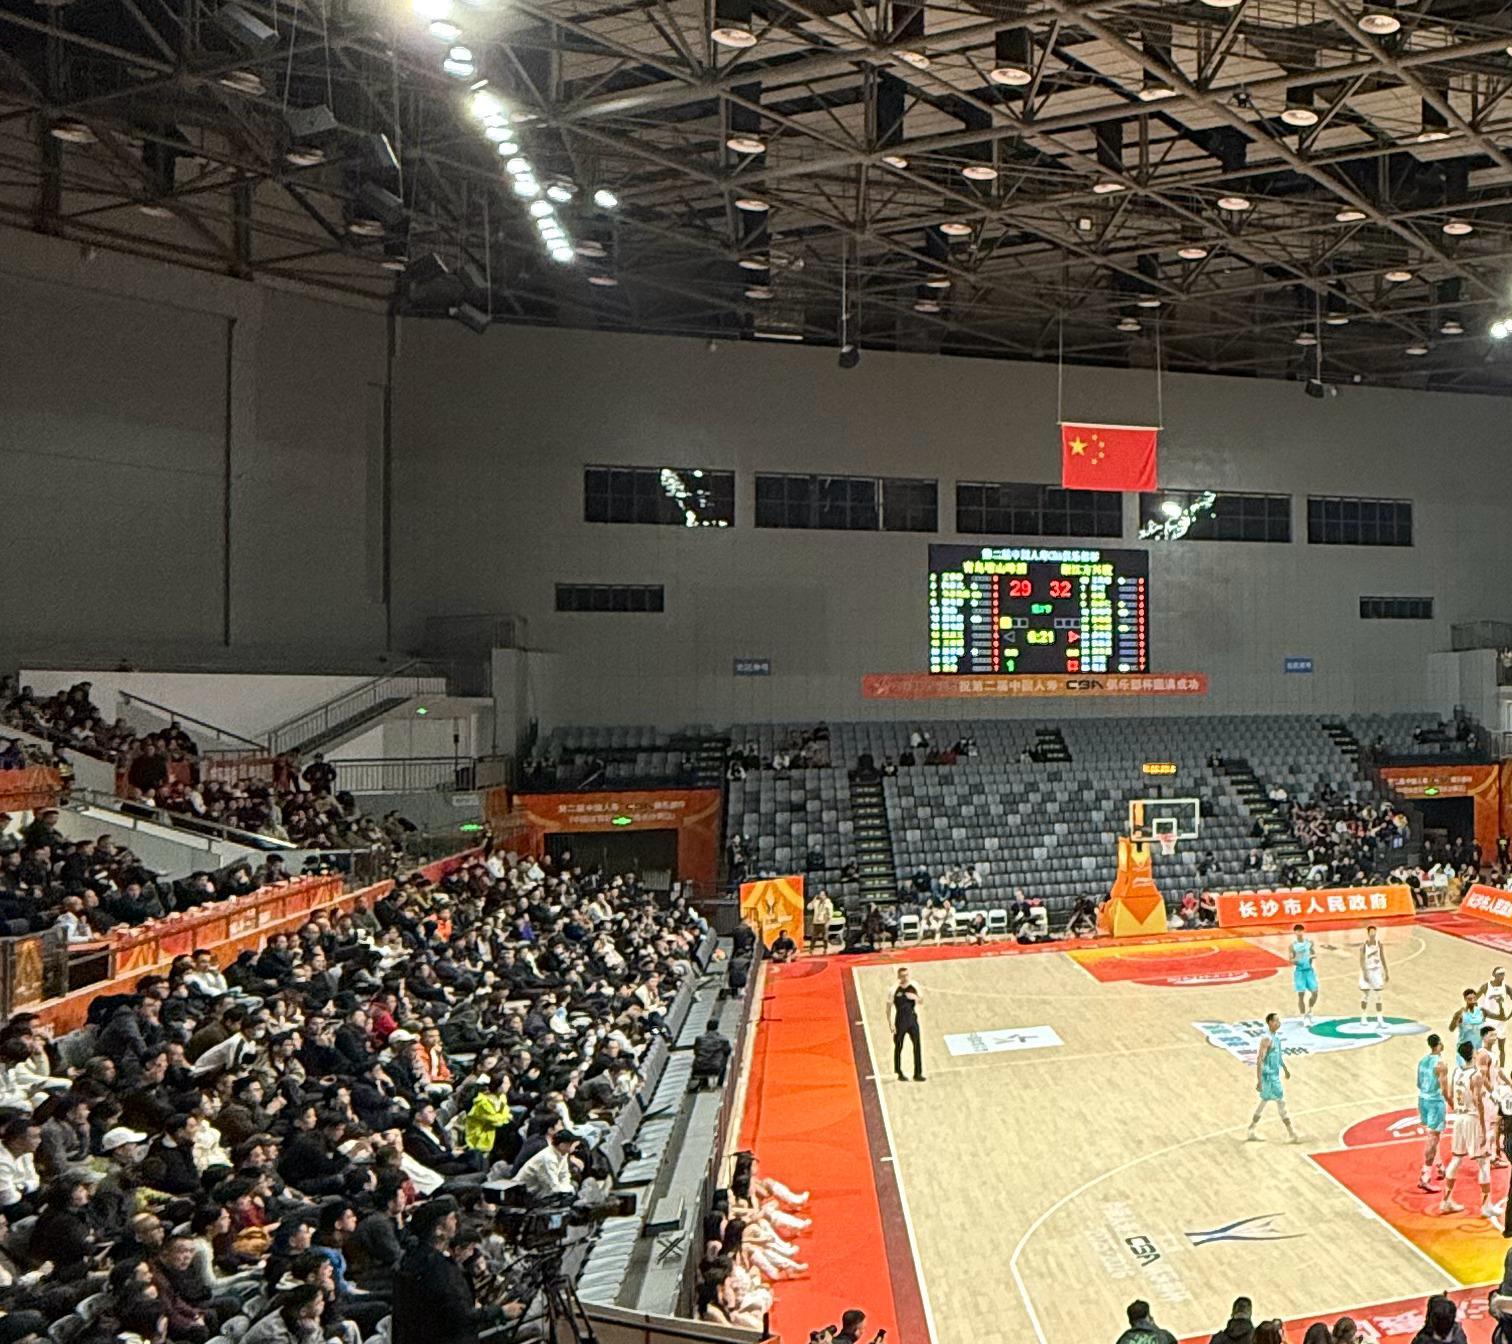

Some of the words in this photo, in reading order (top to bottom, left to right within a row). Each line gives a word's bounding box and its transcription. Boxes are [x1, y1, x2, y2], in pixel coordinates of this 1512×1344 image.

[1009, 579, 1032, 597] 29
[1049, 580, 1072, 598] 32
[1238, 893, 1388, 919] 长沙市人民政府
